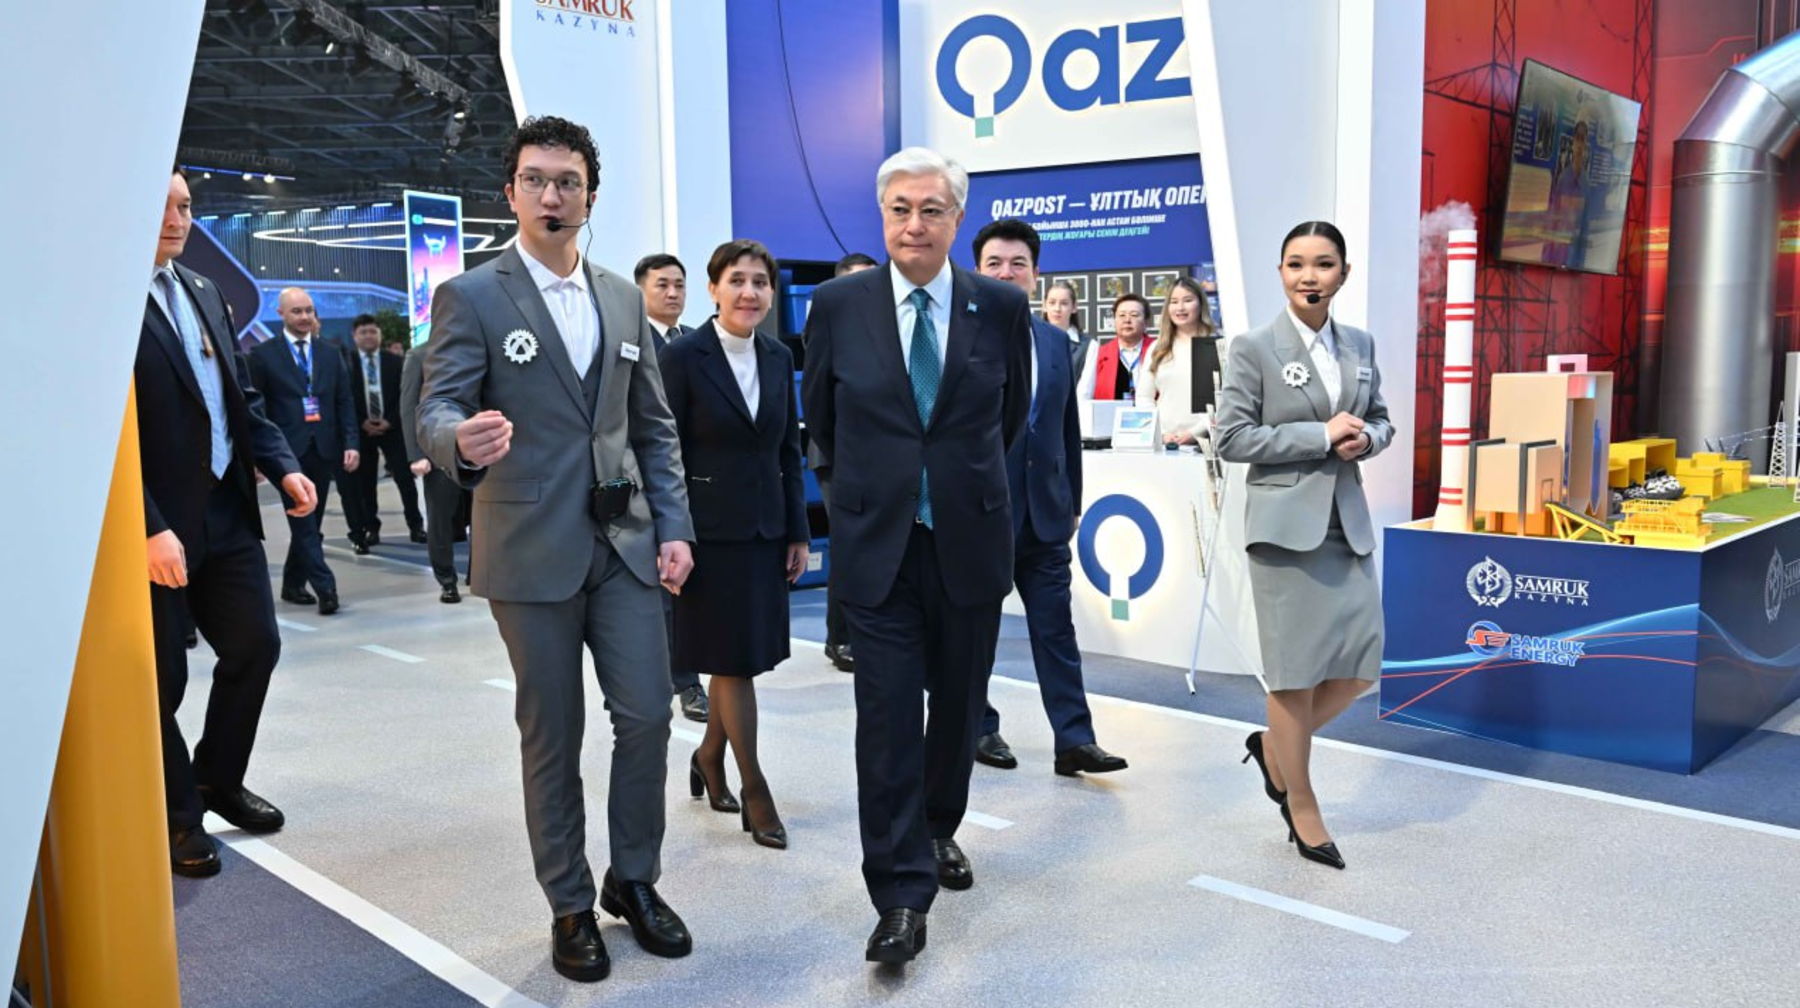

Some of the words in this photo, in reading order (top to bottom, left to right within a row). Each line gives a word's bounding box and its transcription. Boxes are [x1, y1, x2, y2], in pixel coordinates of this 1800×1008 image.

[536, 9, 635, 38] KAZYNA
[991, 195, 1066, 221] QAZPOST
[1515, 577, 1589, 596] SAMRUK
[1514, 592, 1589, 606] KAZYNA
[1511, 634, 1585, 655] SAMRUK
[1511, 648, 1579, 666] ENERGY
